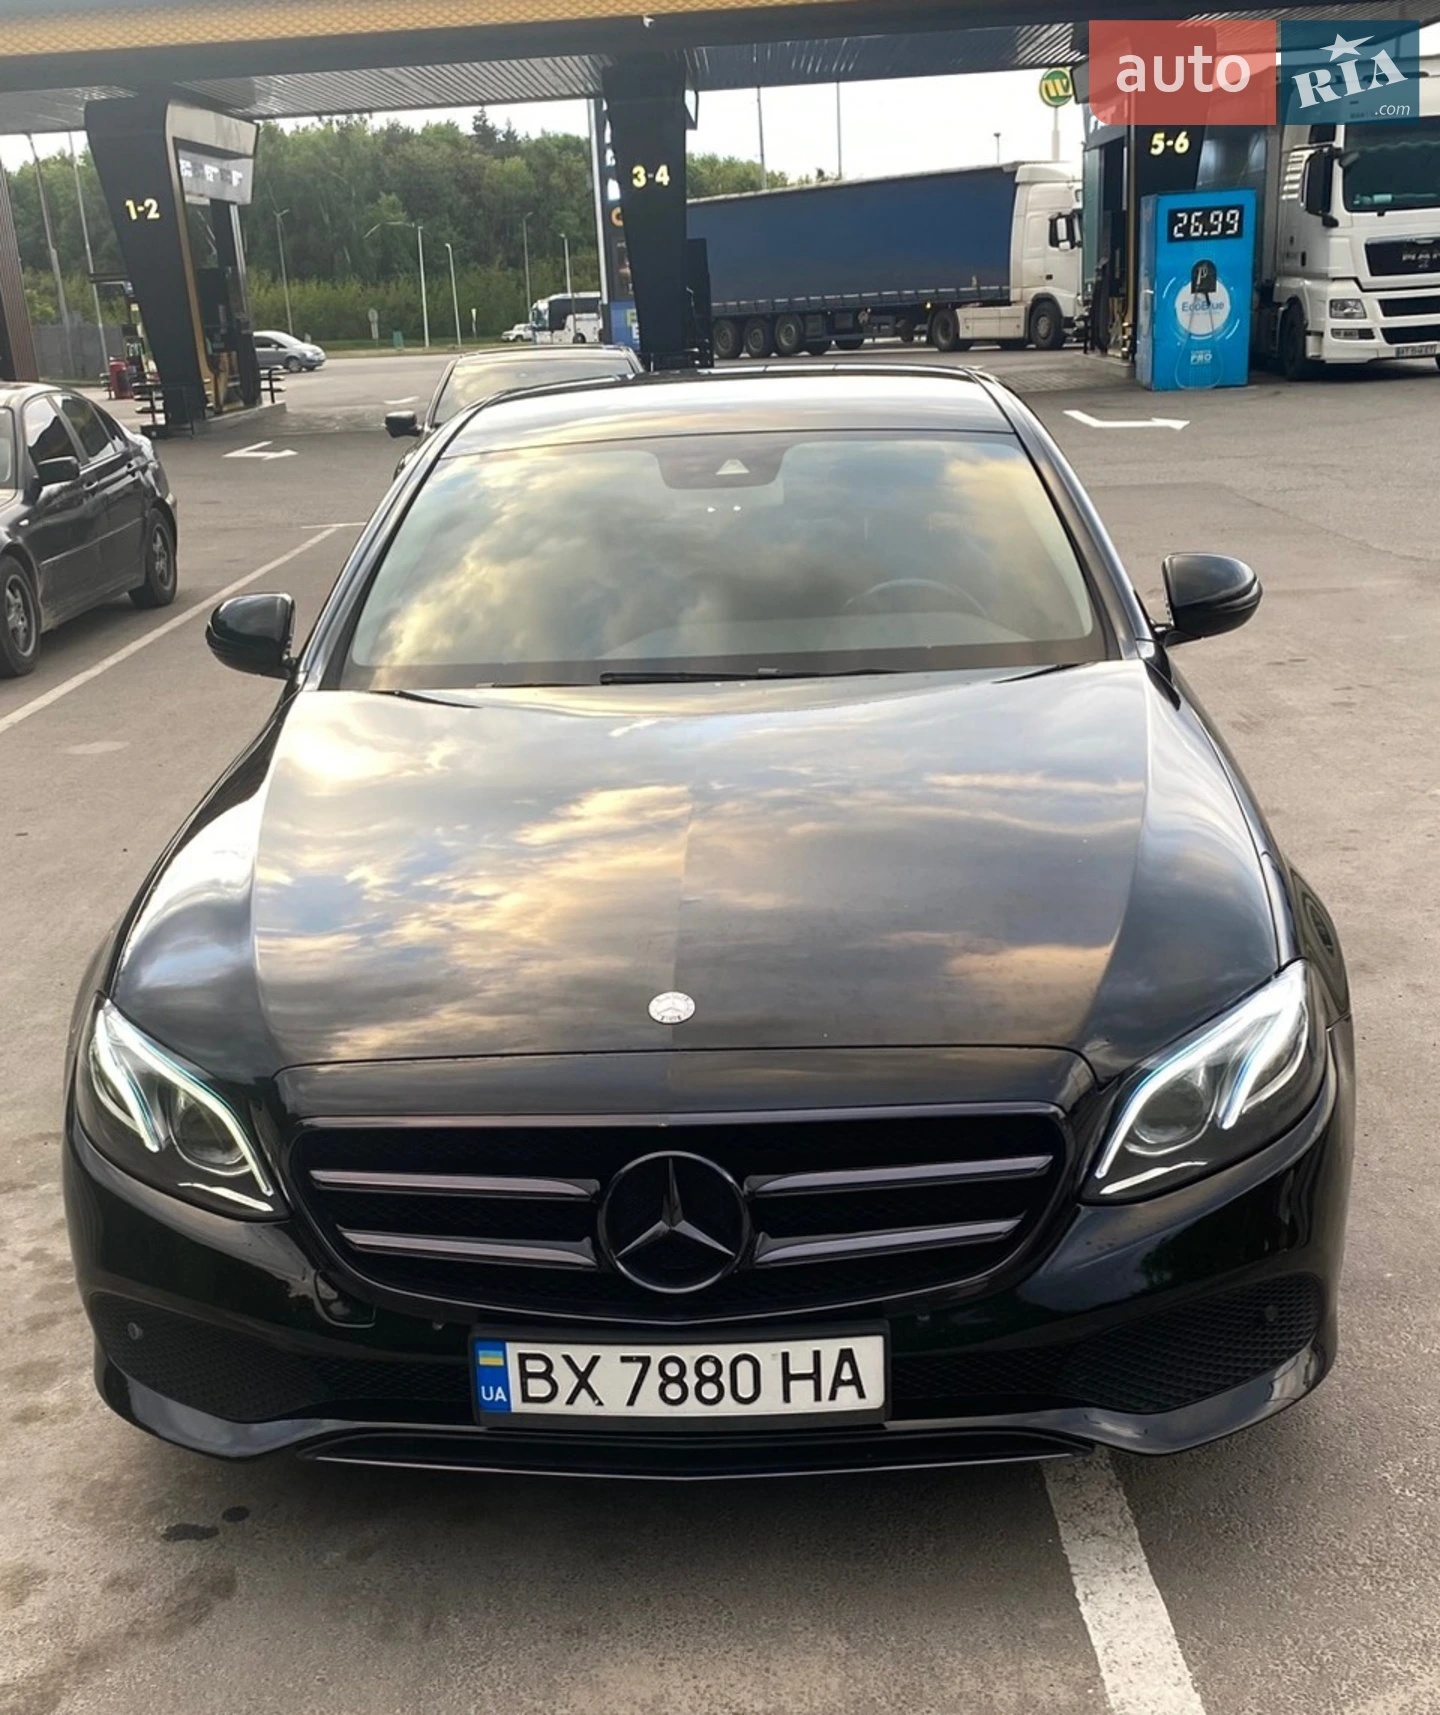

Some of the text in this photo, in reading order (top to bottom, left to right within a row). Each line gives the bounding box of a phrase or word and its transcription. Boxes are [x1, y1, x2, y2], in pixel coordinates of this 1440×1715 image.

[1150, 131, 1190, 155] 5-6
[632, 164, 670, 188] 3-4
[125, 198, 160, 220] 1-2
[1173, 209, 1240, 238] 26.99
[517, 1347, 867, 1406] BX 7880 HA
[481, 1385, 507, 1402] UA
